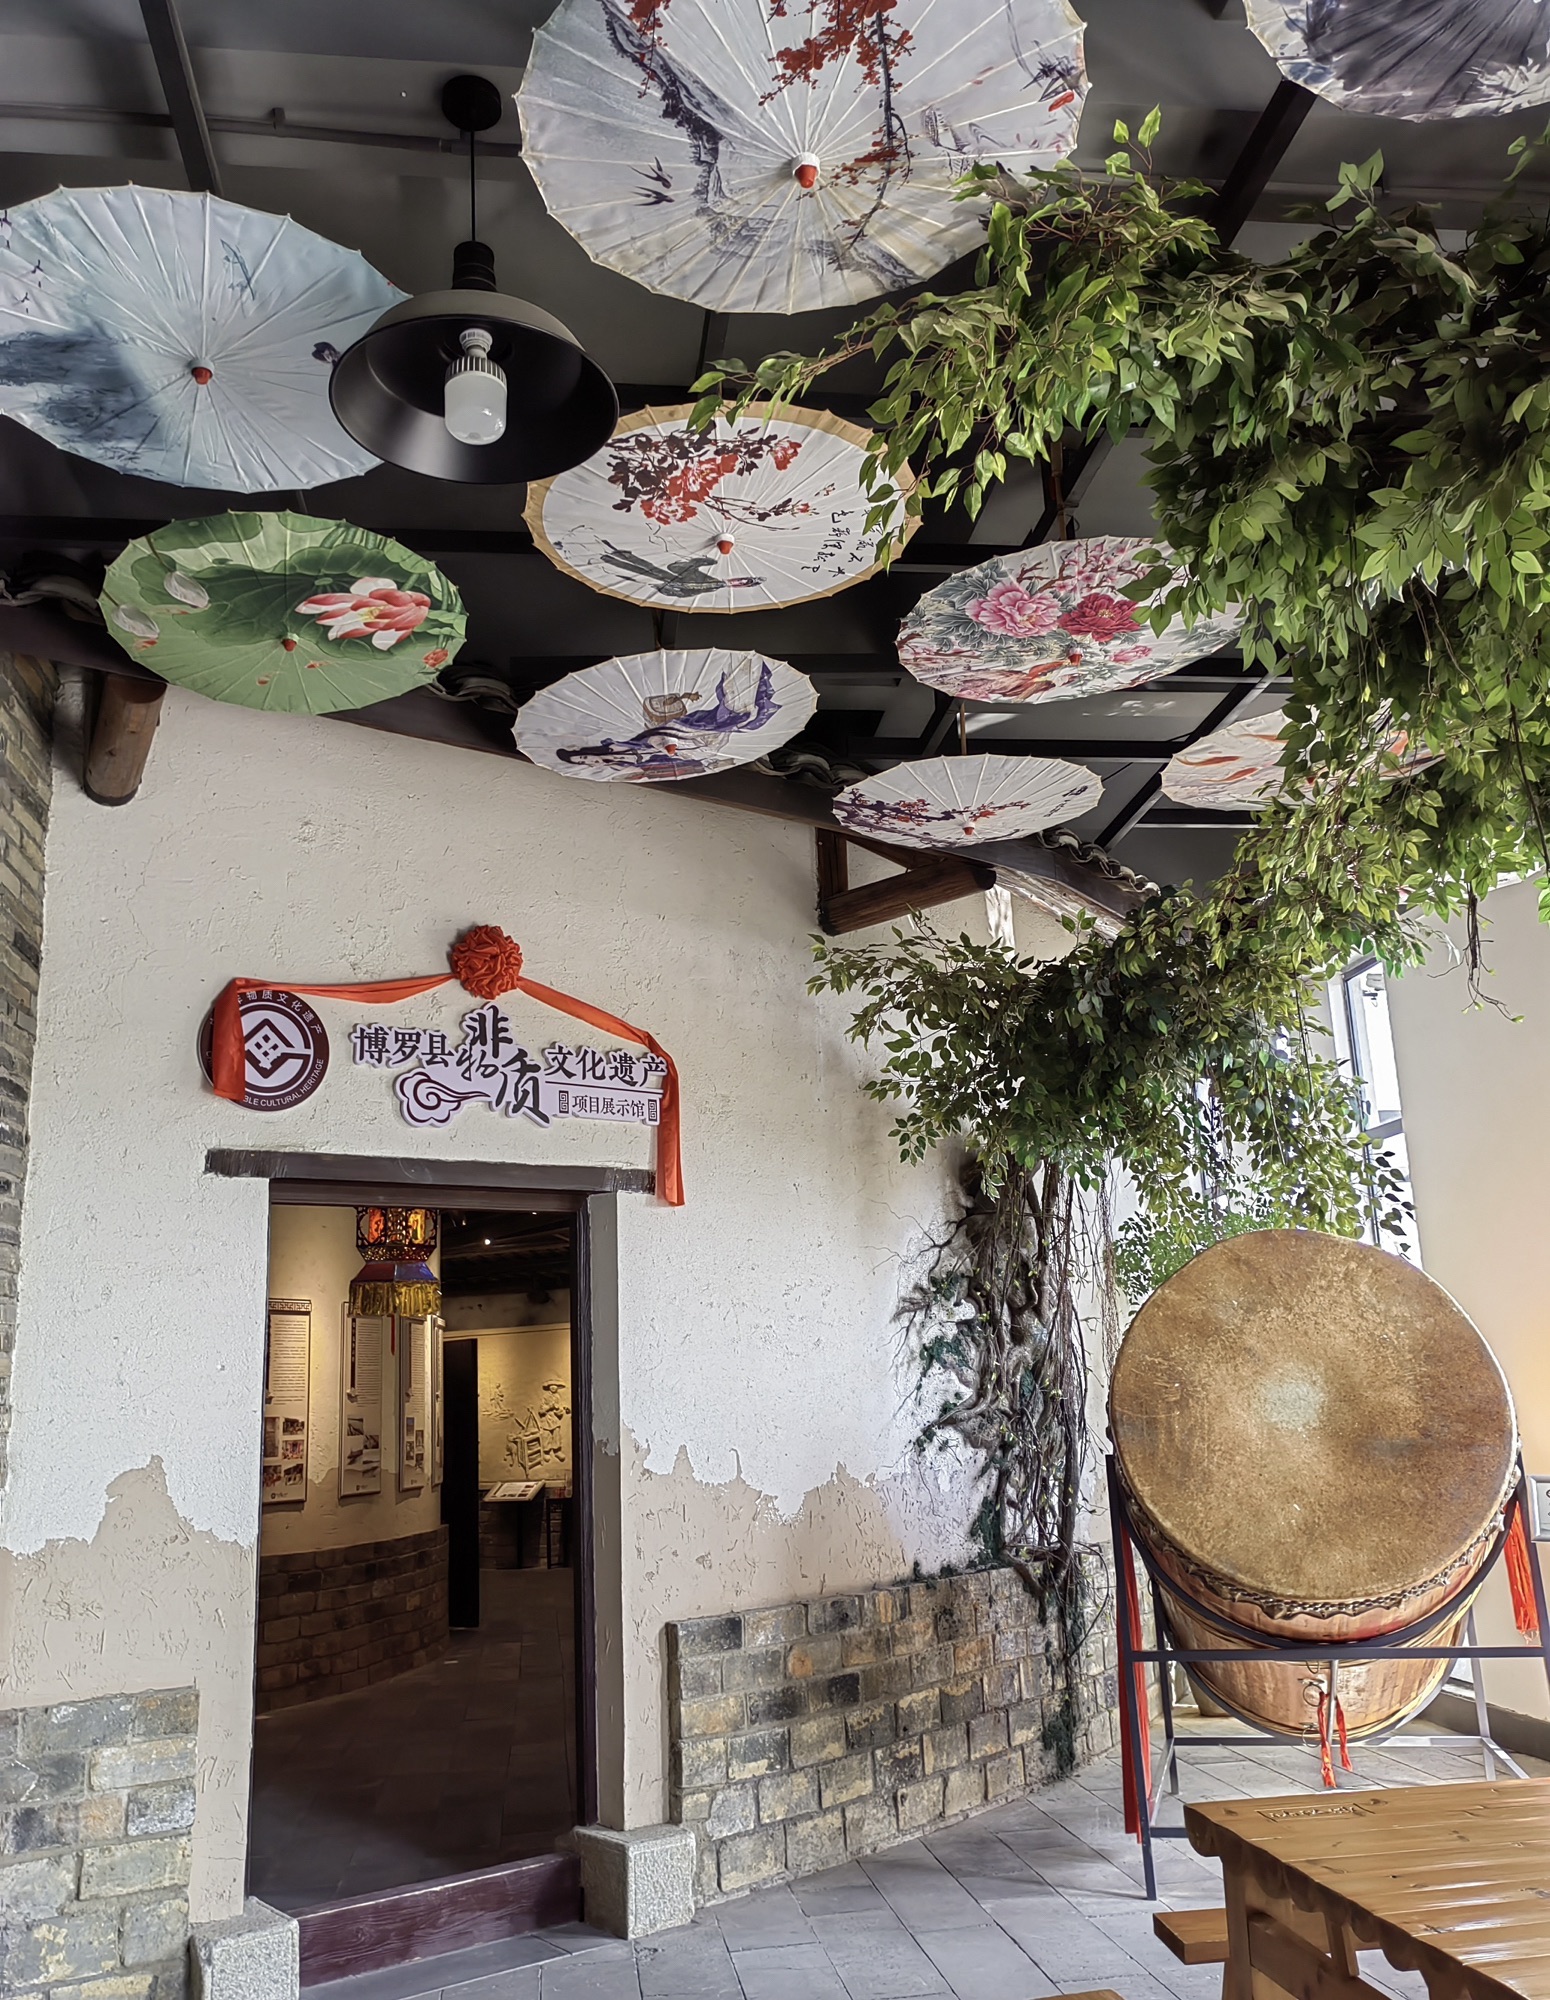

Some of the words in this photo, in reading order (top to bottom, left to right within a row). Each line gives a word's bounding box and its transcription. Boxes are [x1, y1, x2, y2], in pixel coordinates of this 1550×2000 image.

[354, 1026, 454, 1068] 博罗县
[544, 1045, 666, 1088] 文化遗产
[260, 1092, 303, 1107] CULTURAL
[300, 1058, 325, 1094] HERITAGE
[572, 1094, 646, 1118] 项目展示馆
